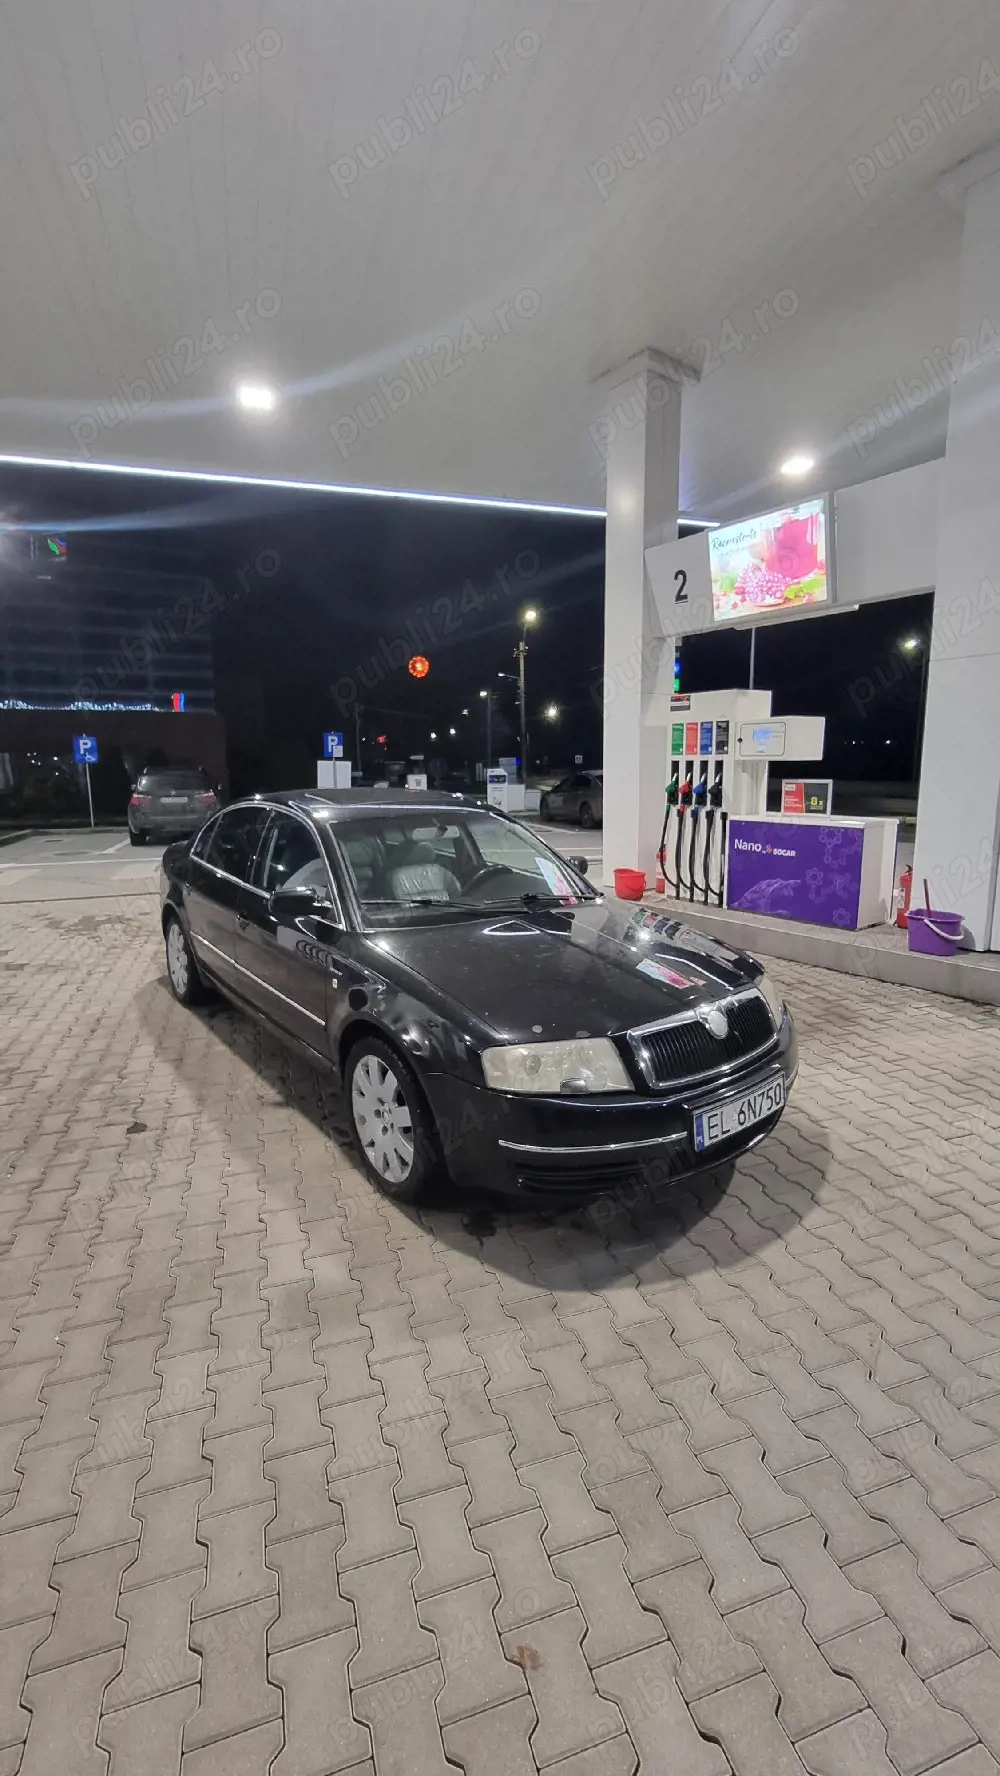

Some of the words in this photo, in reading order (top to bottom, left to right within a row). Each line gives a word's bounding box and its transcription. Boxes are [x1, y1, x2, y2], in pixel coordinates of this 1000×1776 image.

[674, 569, 688, 602] 2
[79, 739, 91, 755] P
[328, 735, 338, 752] P
[734, 839, 762, 852] Nano
[773, 848, 796, 857] SOCAR
[707, 1110, 731, 1141] EL
[737, 1082, 782, 1127] 6N750
